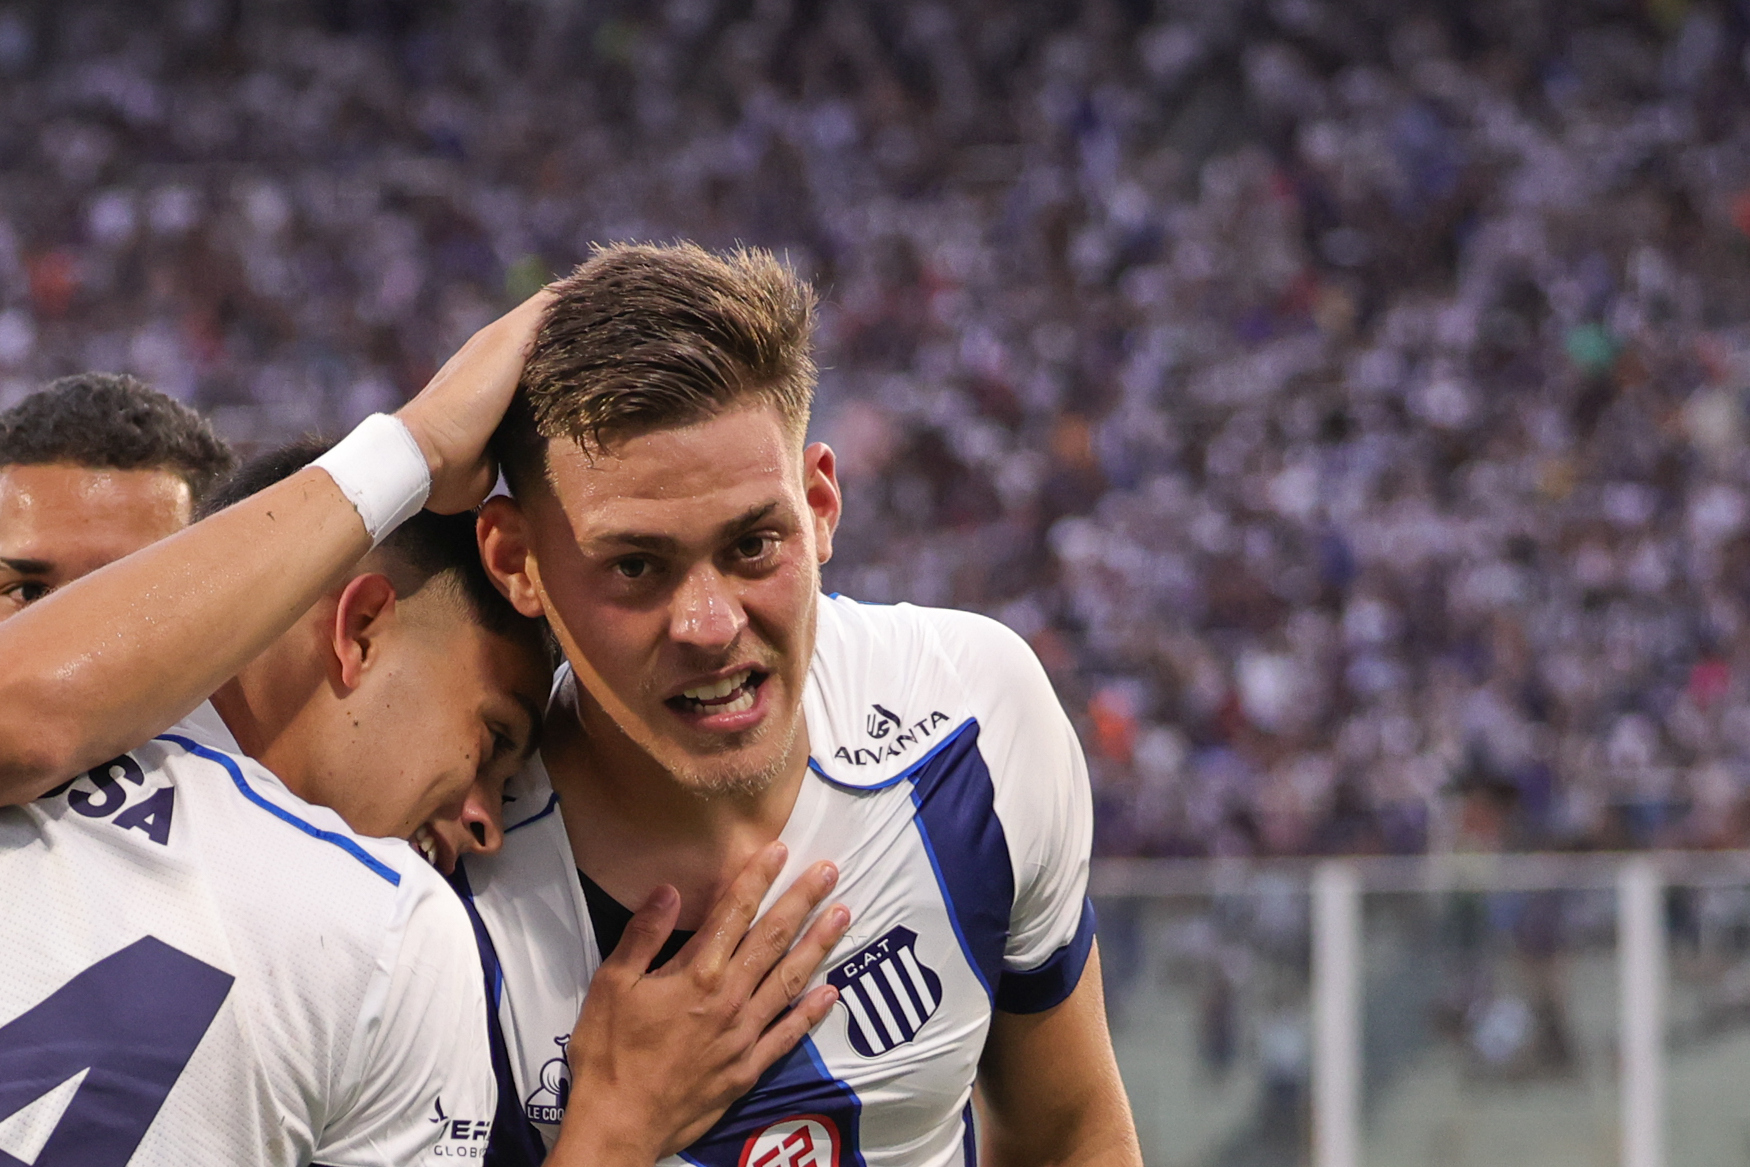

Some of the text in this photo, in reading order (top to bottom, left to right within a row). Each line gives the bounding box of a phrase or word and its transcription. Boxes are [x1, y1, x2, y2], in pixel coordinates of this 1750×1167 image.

[834, 711, 950, 765] ADVANTA
[40, 753, 175, 846] SA
[843, 938, 890, 978] C.A.T
[527, 1106, 540, 1119] LE
